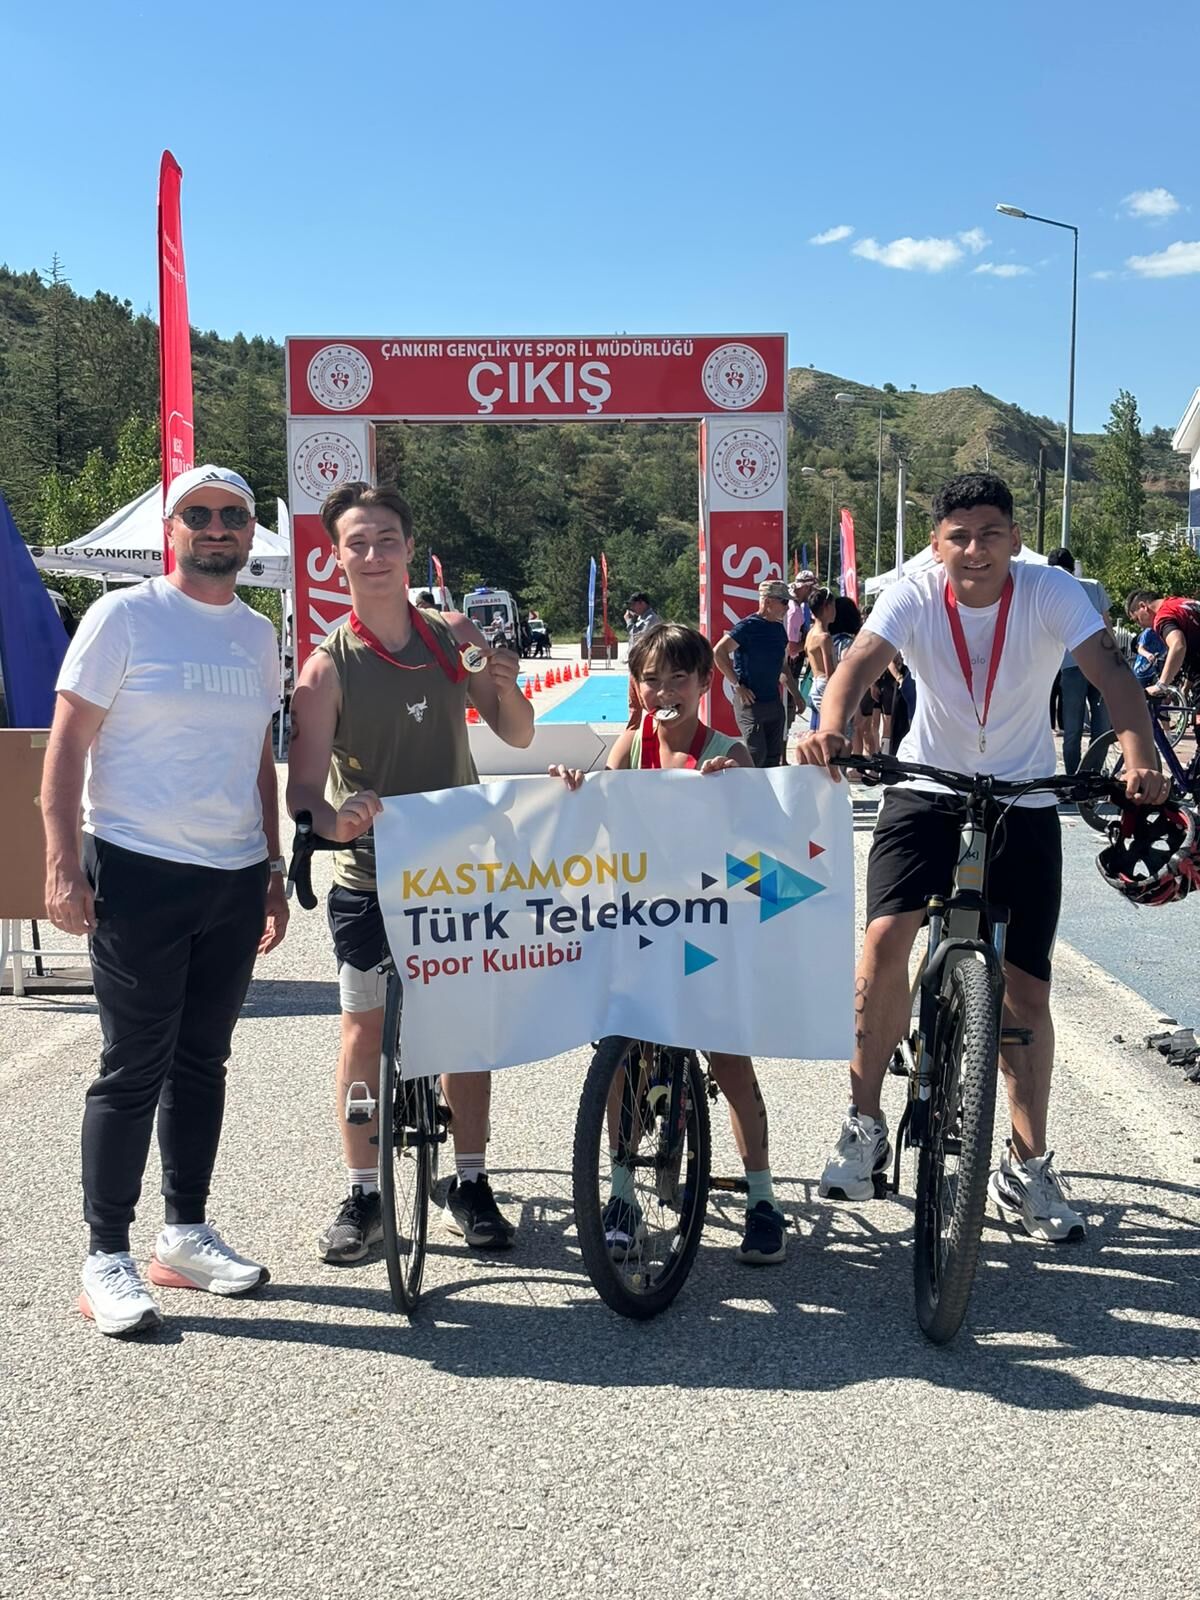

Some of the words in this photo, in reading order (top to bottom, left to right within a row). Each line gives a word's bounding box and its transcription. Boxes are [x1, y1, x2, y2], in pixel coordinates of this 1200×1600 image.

[381, 343, 443, 361] ÇANKIRI
[446, 340, 511, 361] GENÇLİK
[513, 343, 533, 357] VE
[536, 343, 576, 357] SPOR
[579, 340, 593, 357] İL
[596, 340, 694, 357] MÜDÜRLÜĞÜ
[467, 361, 612, 414] ÇIKIŞ
[83, 547, 148, 560] ÇANKIRI
[183, 661, 261, 697] PUMA
[402, 852, 648, 900] KASTAMONU
[403, 902, 510, 947] Türk
[526, 891, 728, 936] Telekom
[405, 954, 473, 985] Spor
[482, 941, 583, 973] Kulübü
